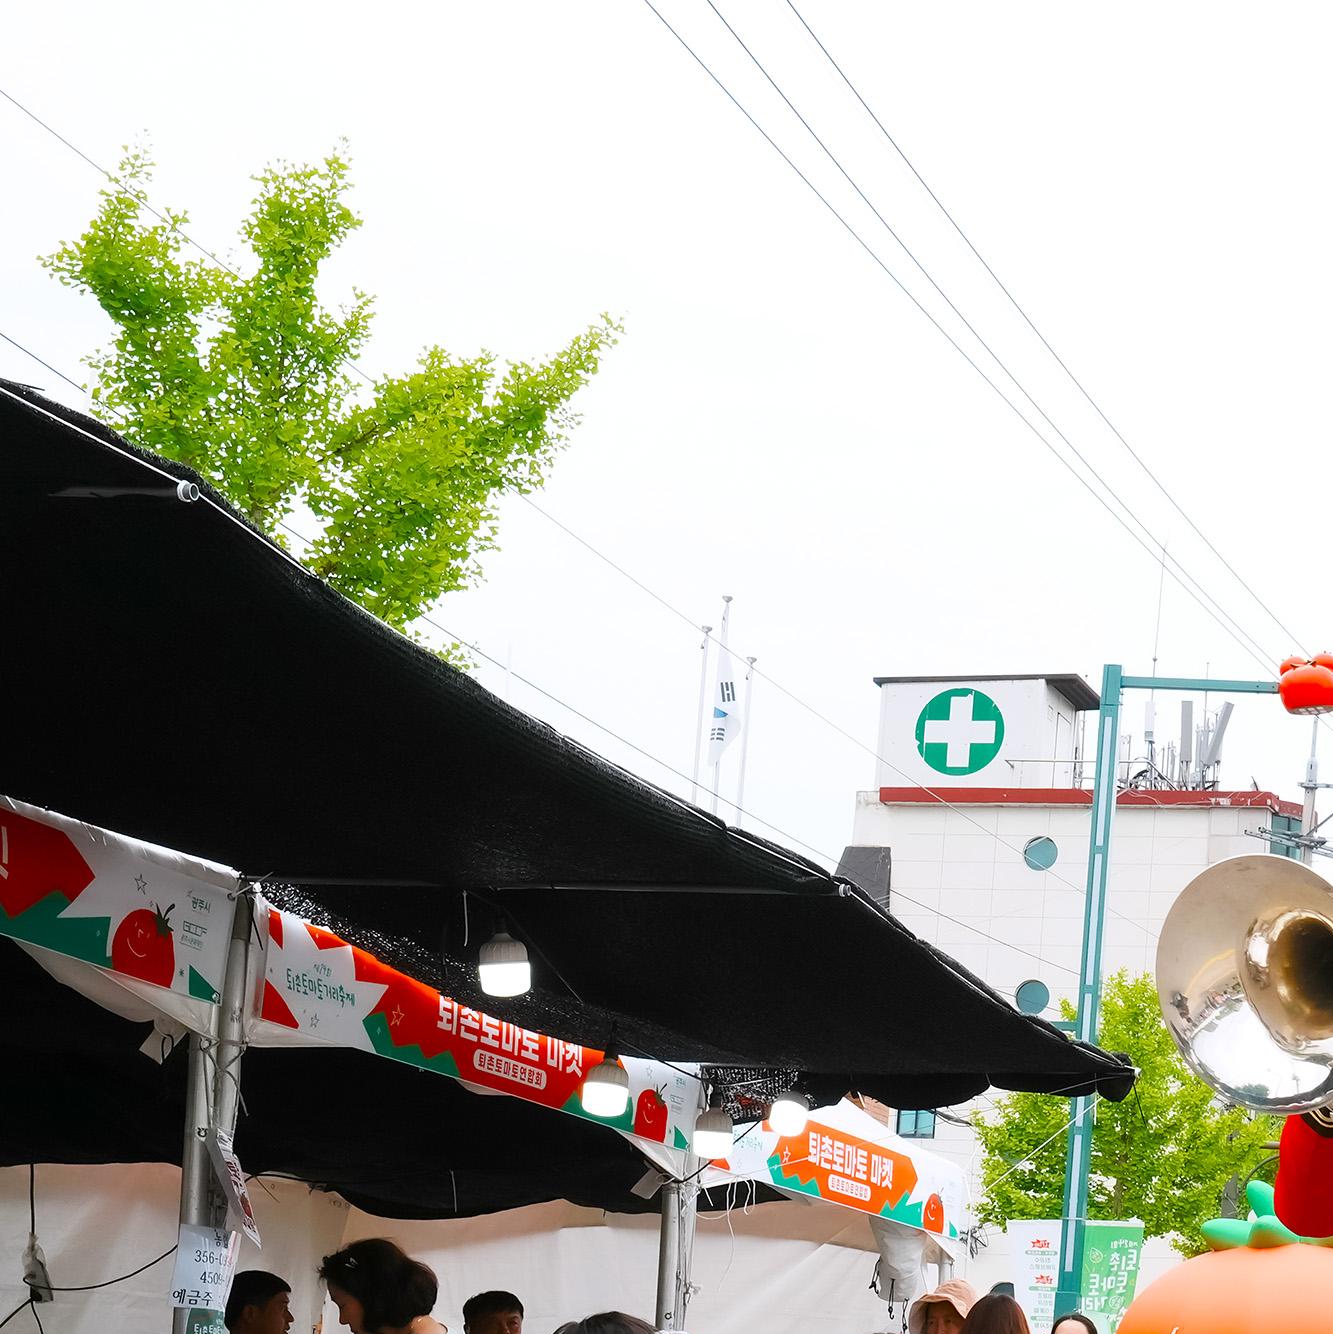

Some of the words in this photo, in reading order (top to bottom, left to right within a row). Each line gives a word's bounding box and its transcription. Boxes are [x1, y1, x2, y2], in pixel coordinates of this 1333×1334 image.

[478, 1053, 544, 1088] 퇴촌토마토연합회
[807, 1131, 869, 1181] 퇴촌토마토
[870, 1153, 893, 1190] 마켓
[172, 1288, 213, 1306] 예금주
